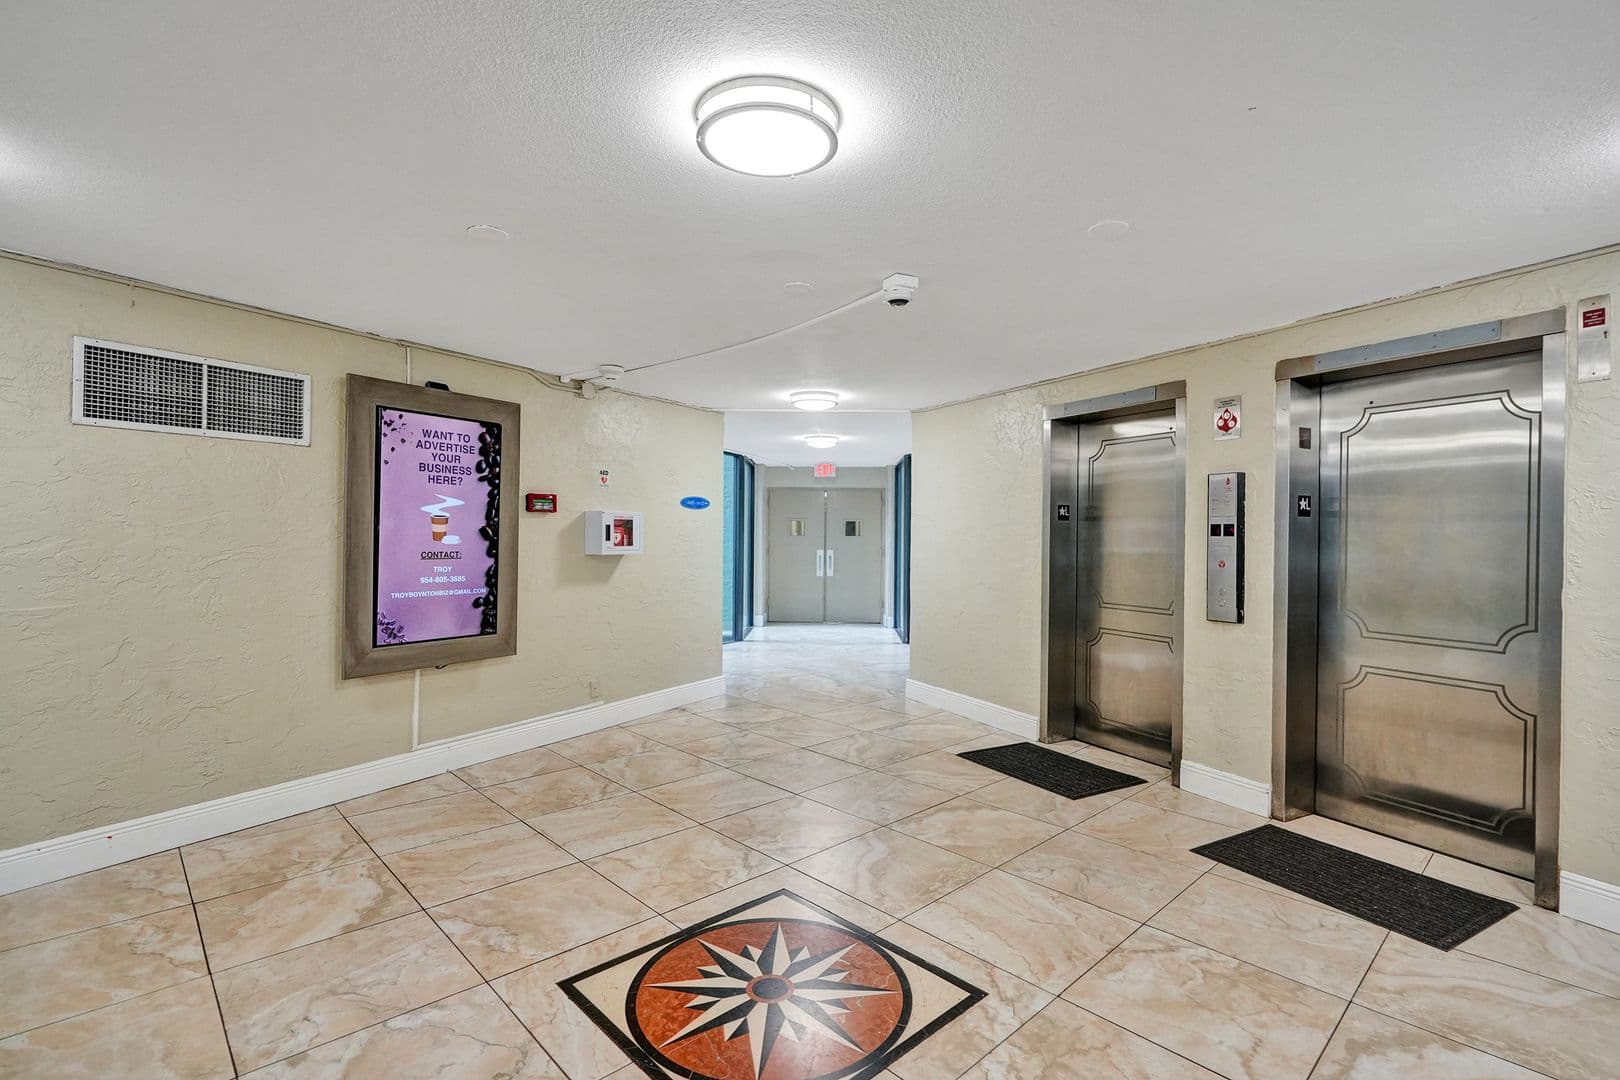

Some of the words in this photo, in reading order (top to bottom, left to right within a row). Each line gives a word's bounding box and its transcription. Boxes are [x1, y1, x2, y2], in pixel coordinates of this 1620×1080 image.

[422, 428, 455, 441] WANT
[457, 432, 471, 443] TO
[415, 439, 476, 455] ADVERTISE
[431, 452, 461, 464] YOUR
[418, 462, 473, 476] BUSINESS
[427, 474, 463, 486] HERE?
[420, 551, 462, 560] CONTACT:
